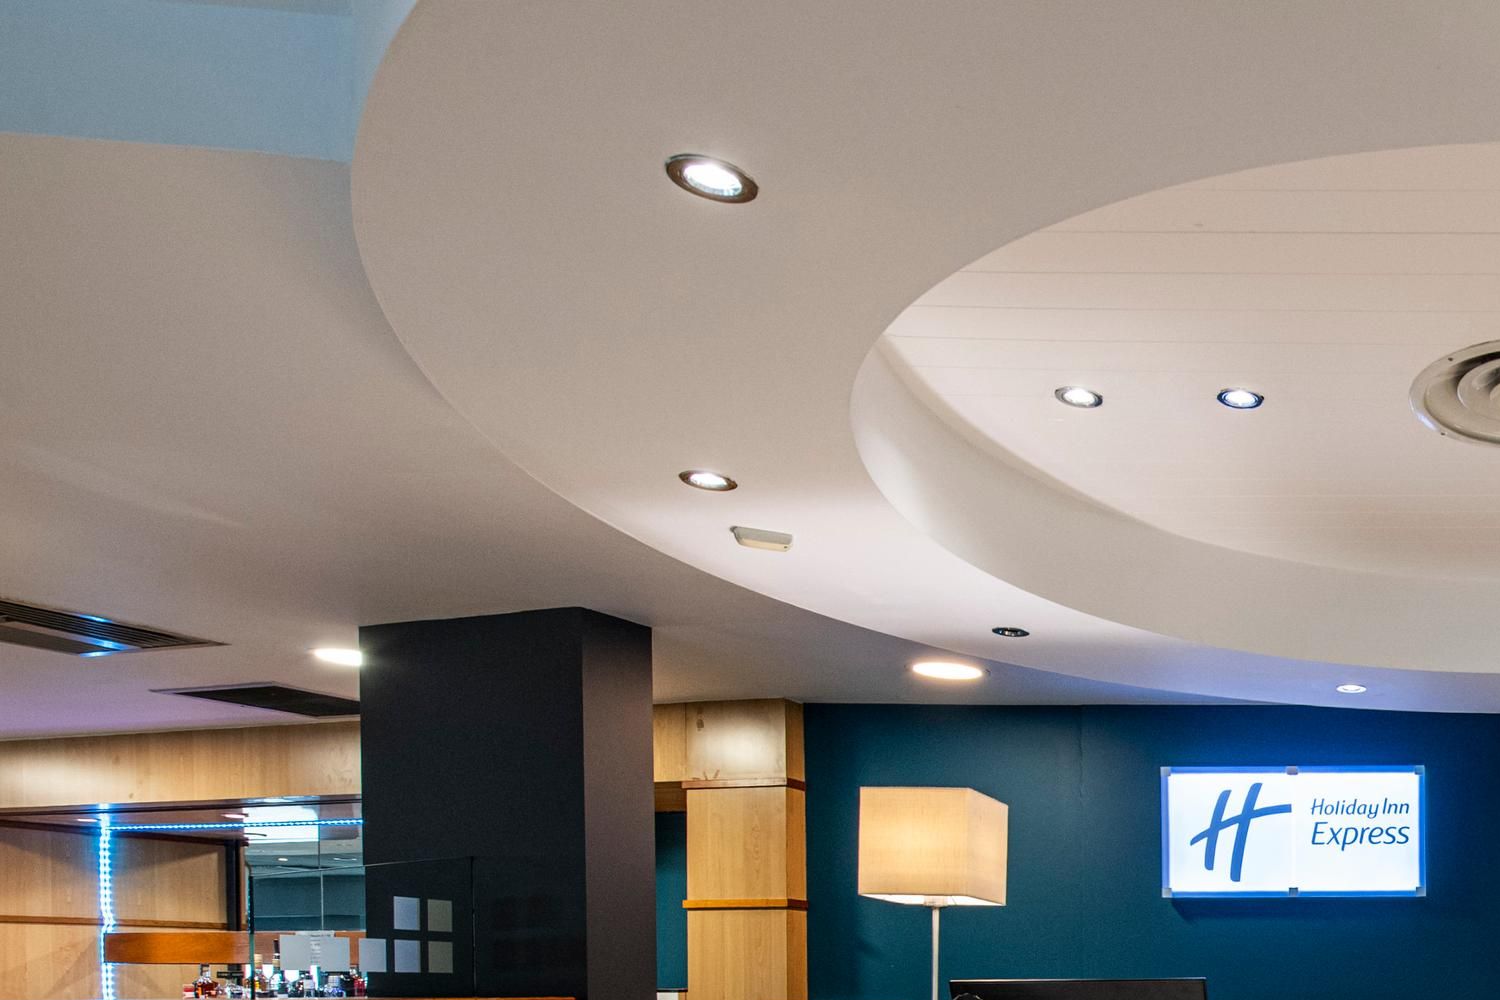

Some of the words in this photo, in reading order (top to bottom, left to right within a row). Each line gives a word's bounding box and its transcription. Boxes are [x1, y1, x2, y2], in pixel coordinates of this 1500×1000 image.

[1310, 797, 1379, 819] Holiday
[1382, 797, 1410, 815] Inn
[1311, 821, 1410, 851] Express
